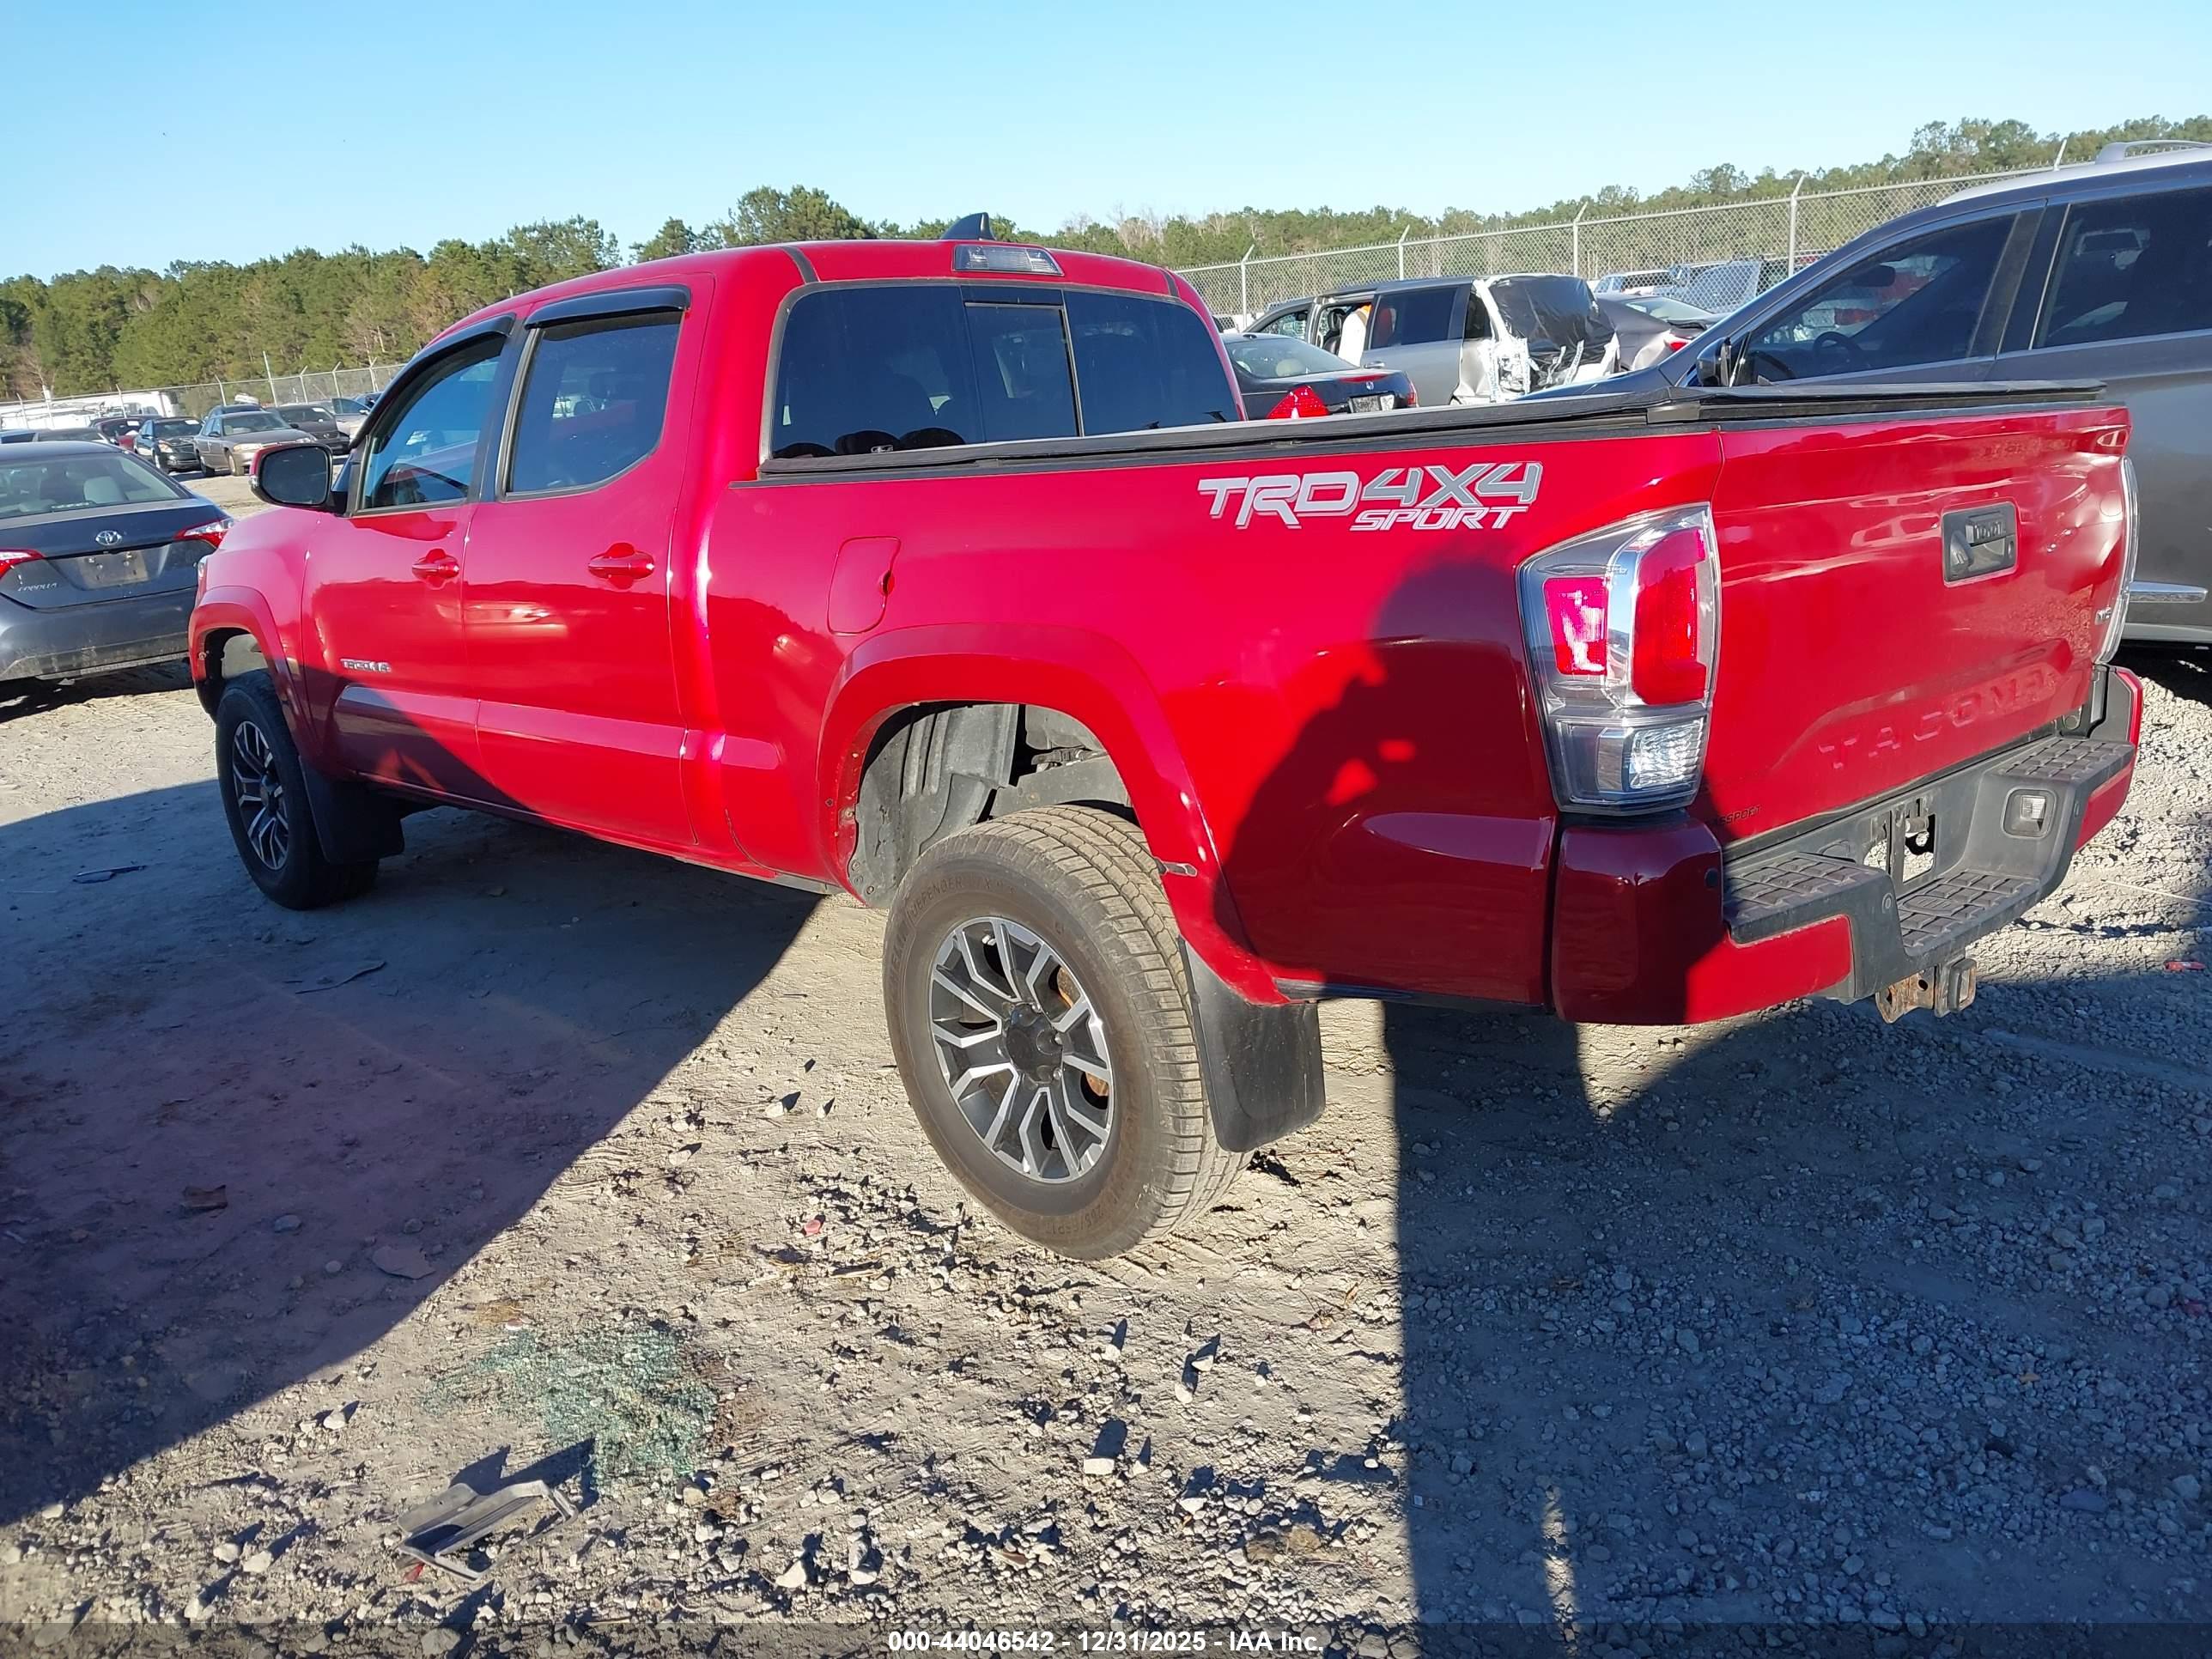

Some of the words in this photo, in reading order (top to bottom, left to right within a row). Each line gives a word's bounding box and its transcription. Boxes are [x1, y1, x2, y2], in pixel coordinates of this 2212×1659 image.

[1198, 471, 1363, 531] TRD
[1362, 460, 1544, 508] 4X4
[1349, 505, 1528, 532] SPORT
[1818, 668, 2057, 769] TACOMA
